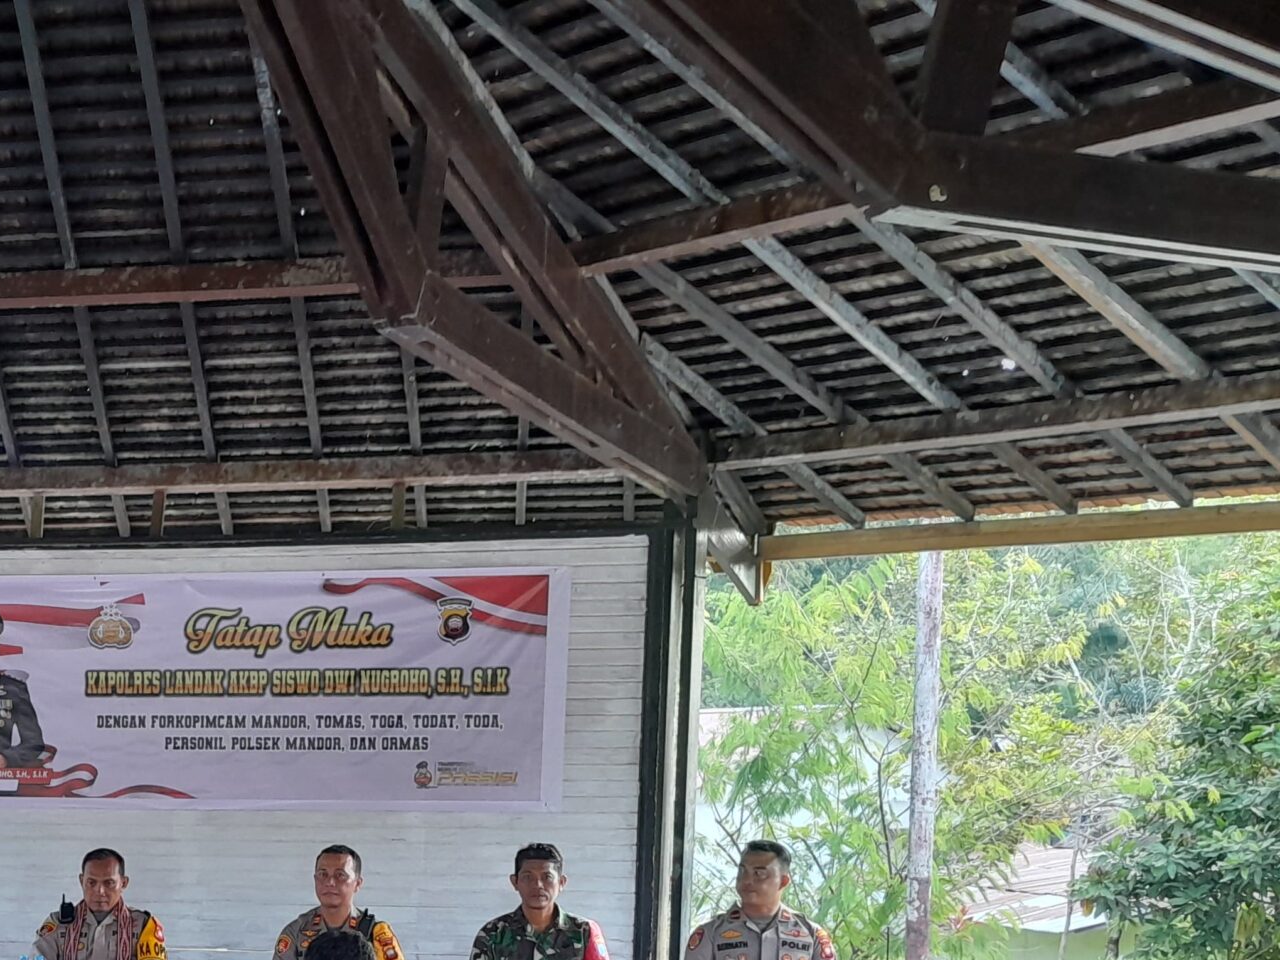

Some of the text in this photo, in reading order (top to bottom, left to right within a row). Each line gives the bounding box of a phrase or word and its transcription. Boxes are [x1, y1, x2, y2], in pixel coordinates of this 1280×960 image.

[184, 606, 394, 658] Tatap Muka
[85, 666, 510, 698] KAPOLRES LANDAK AKBP SISWO DWI NUGROHO, S.H., S.I.K
[96, 714, 504, 731] DENGAN FORKOPIMCAM MANDOR, TOMAS, TOGA, TODAT, TODA,
[164, 737, 429, 752] PERSONIL POLSEK MANDOR, DAN ORMAS
[781, 940, 810, 951] POLRI
